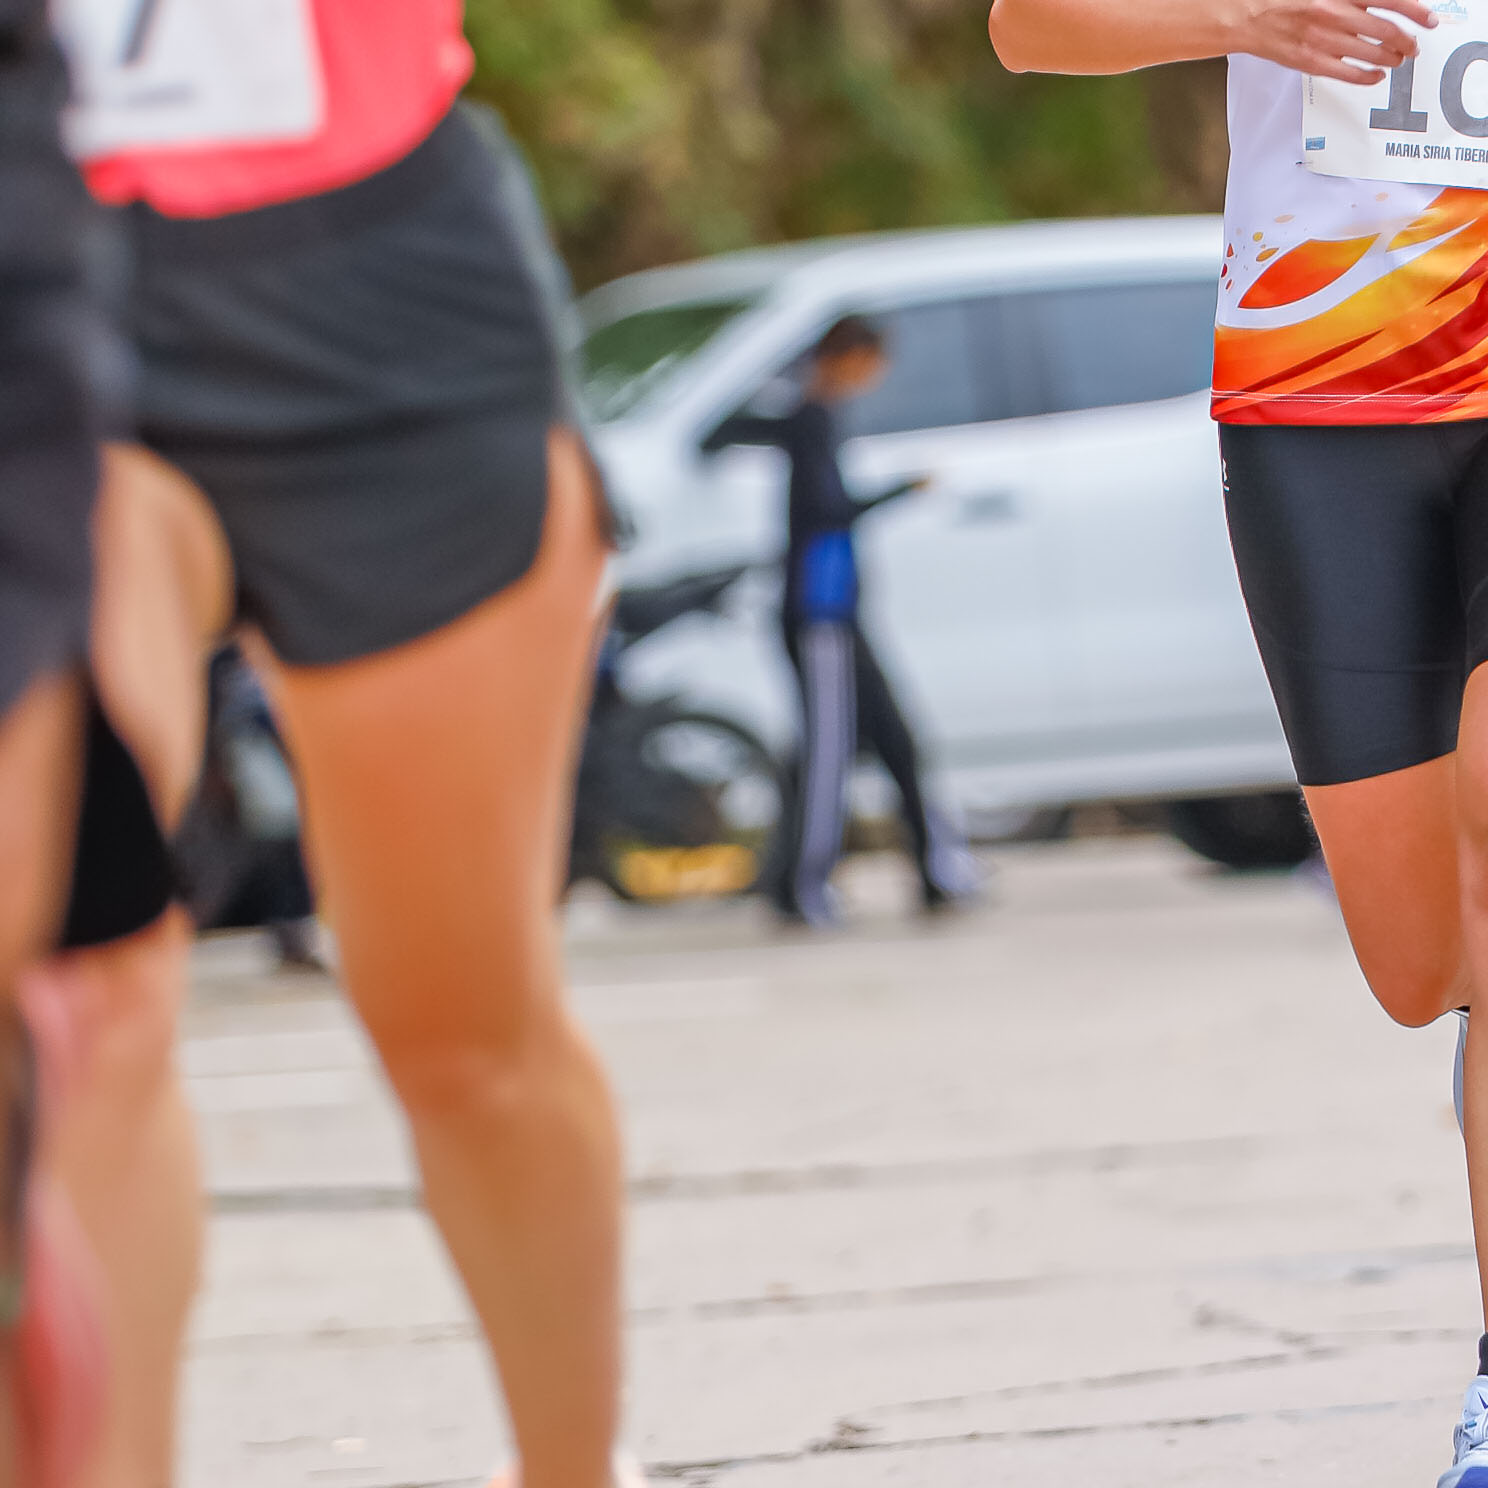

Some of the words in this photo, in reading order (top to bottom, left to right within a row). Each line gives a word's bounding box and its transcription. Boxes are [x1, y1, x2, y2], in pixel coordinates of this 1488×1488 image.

[1385, 142, 1420, 158] MARIA
[1423, 145, 1450, 160] SIRIA
[1455, 147, 1488, 163] TIBERI
